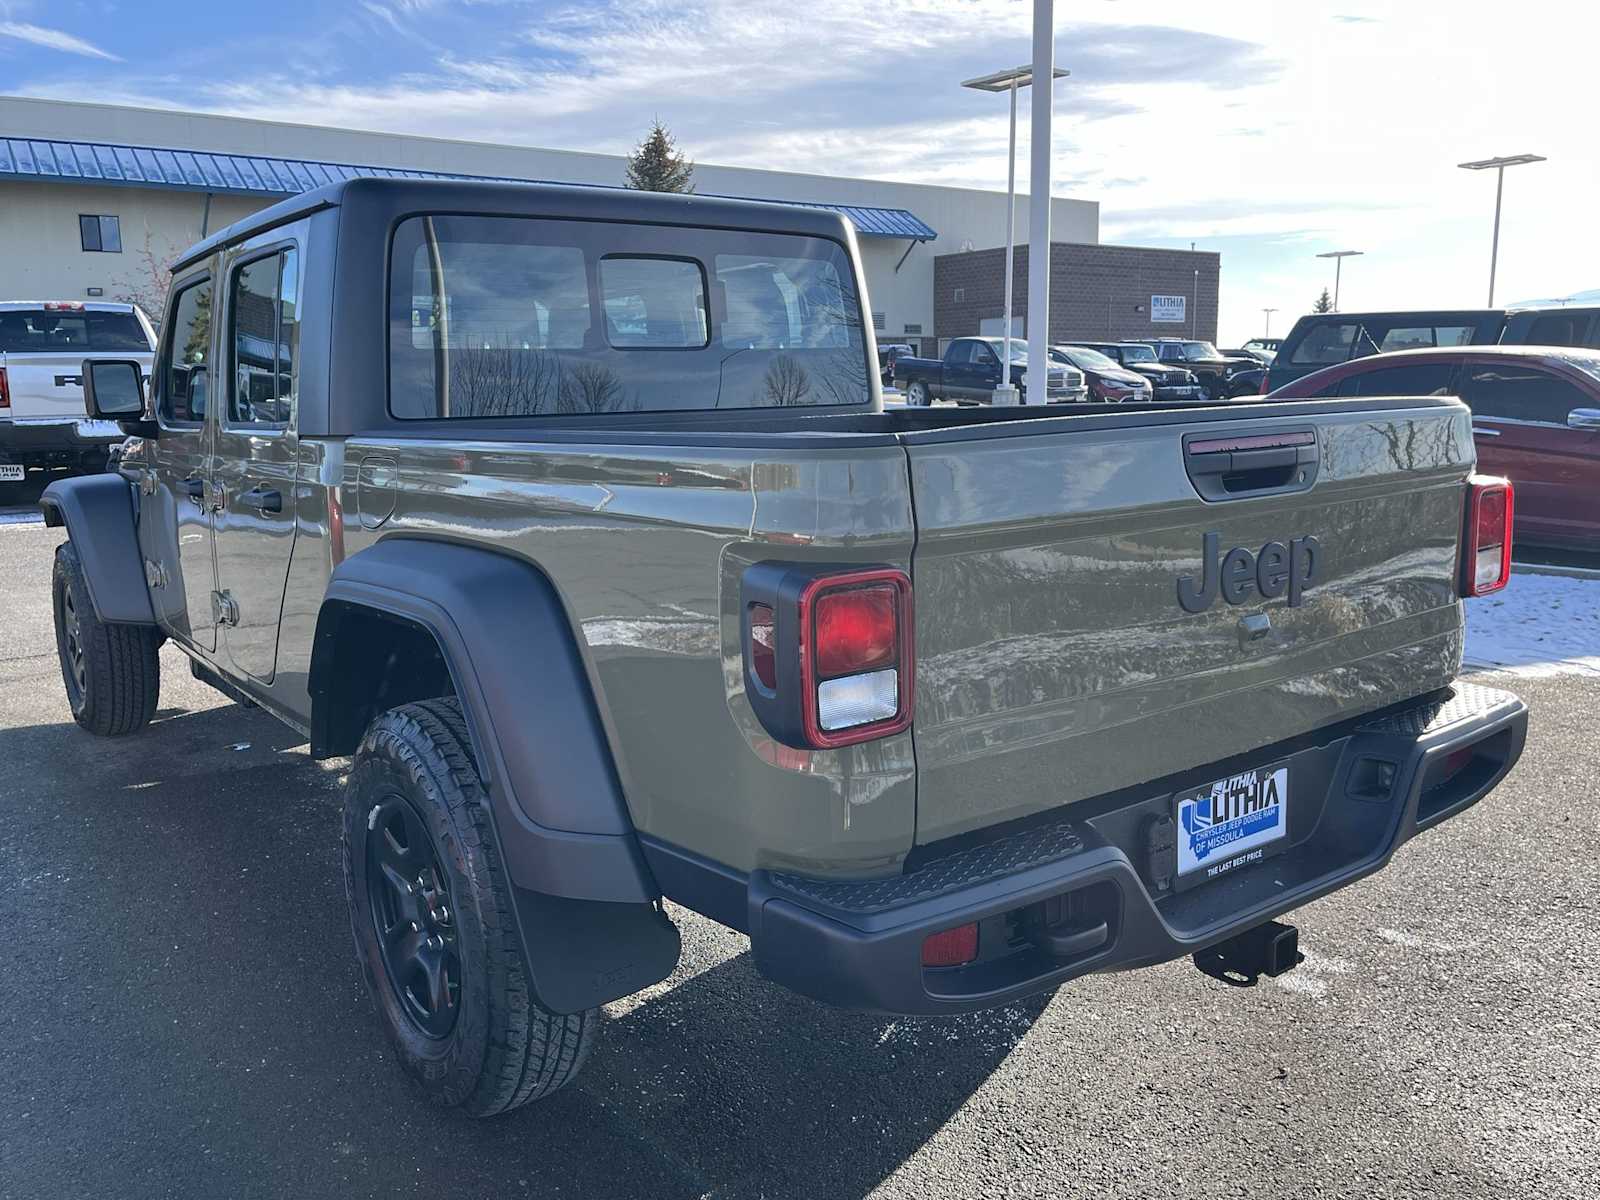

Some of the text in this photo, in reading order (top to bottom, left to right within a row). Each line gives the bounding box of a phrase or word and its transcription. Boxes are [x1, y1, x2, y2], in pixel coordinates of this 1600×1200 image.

[1160, 297, 1184, 307] LITHIA
[1177, 529, 1320, 613] Jeep
[1222, 771, 1257, 793] LITHIA
[1212, 778, 1279, 825] LITHIA
[1196, 808, 1276, 841] CHRYSLER JEEP DODGE RAM
[1195, 828, 1244, 853] OF MISSOULA
[1207, 849, 1263, 877] THE LAST BEST PRICE
